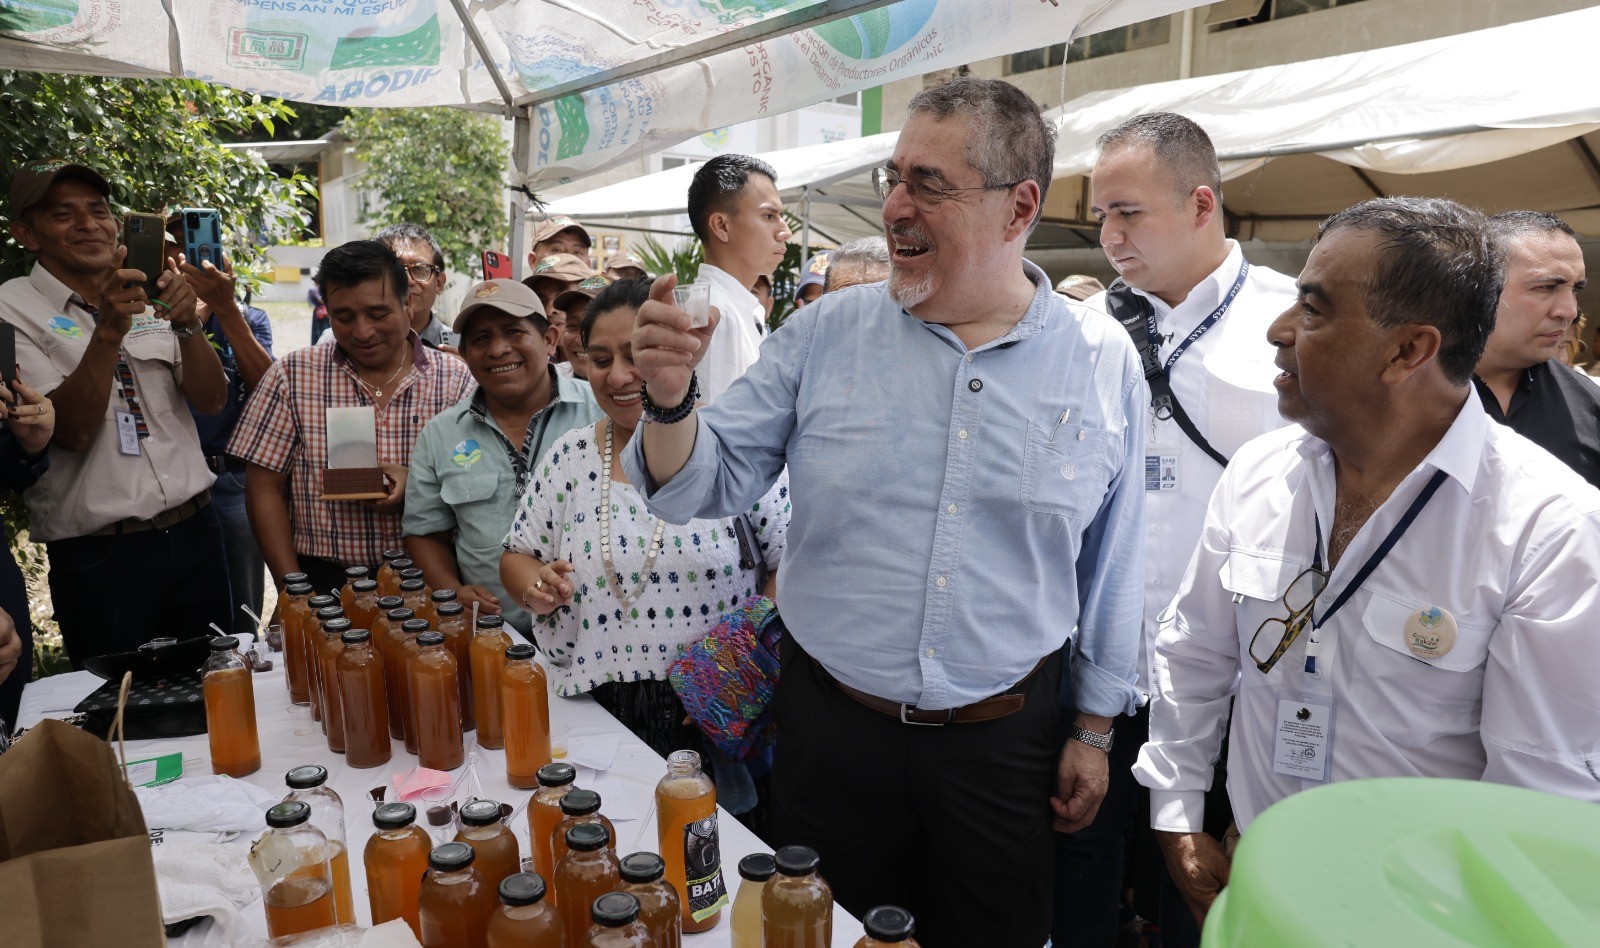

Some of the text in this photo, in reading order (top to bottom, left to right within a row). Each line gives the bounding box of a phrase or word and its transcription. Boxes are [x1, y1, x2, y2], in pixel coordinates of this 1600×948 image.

[333, 7, 355, 15] MI
[828, 56, 839, 70] de
[837, 62, 887, 80] Productores
[889, 28, 938, 72] Orgánicos
[1212, 302, 1228, 321] SAAS
[1147, 315, 1156, 334] SAAS
[1188, 324, 1207, 342] SAAS
[1167, 347, 1184, 367] SAAS
